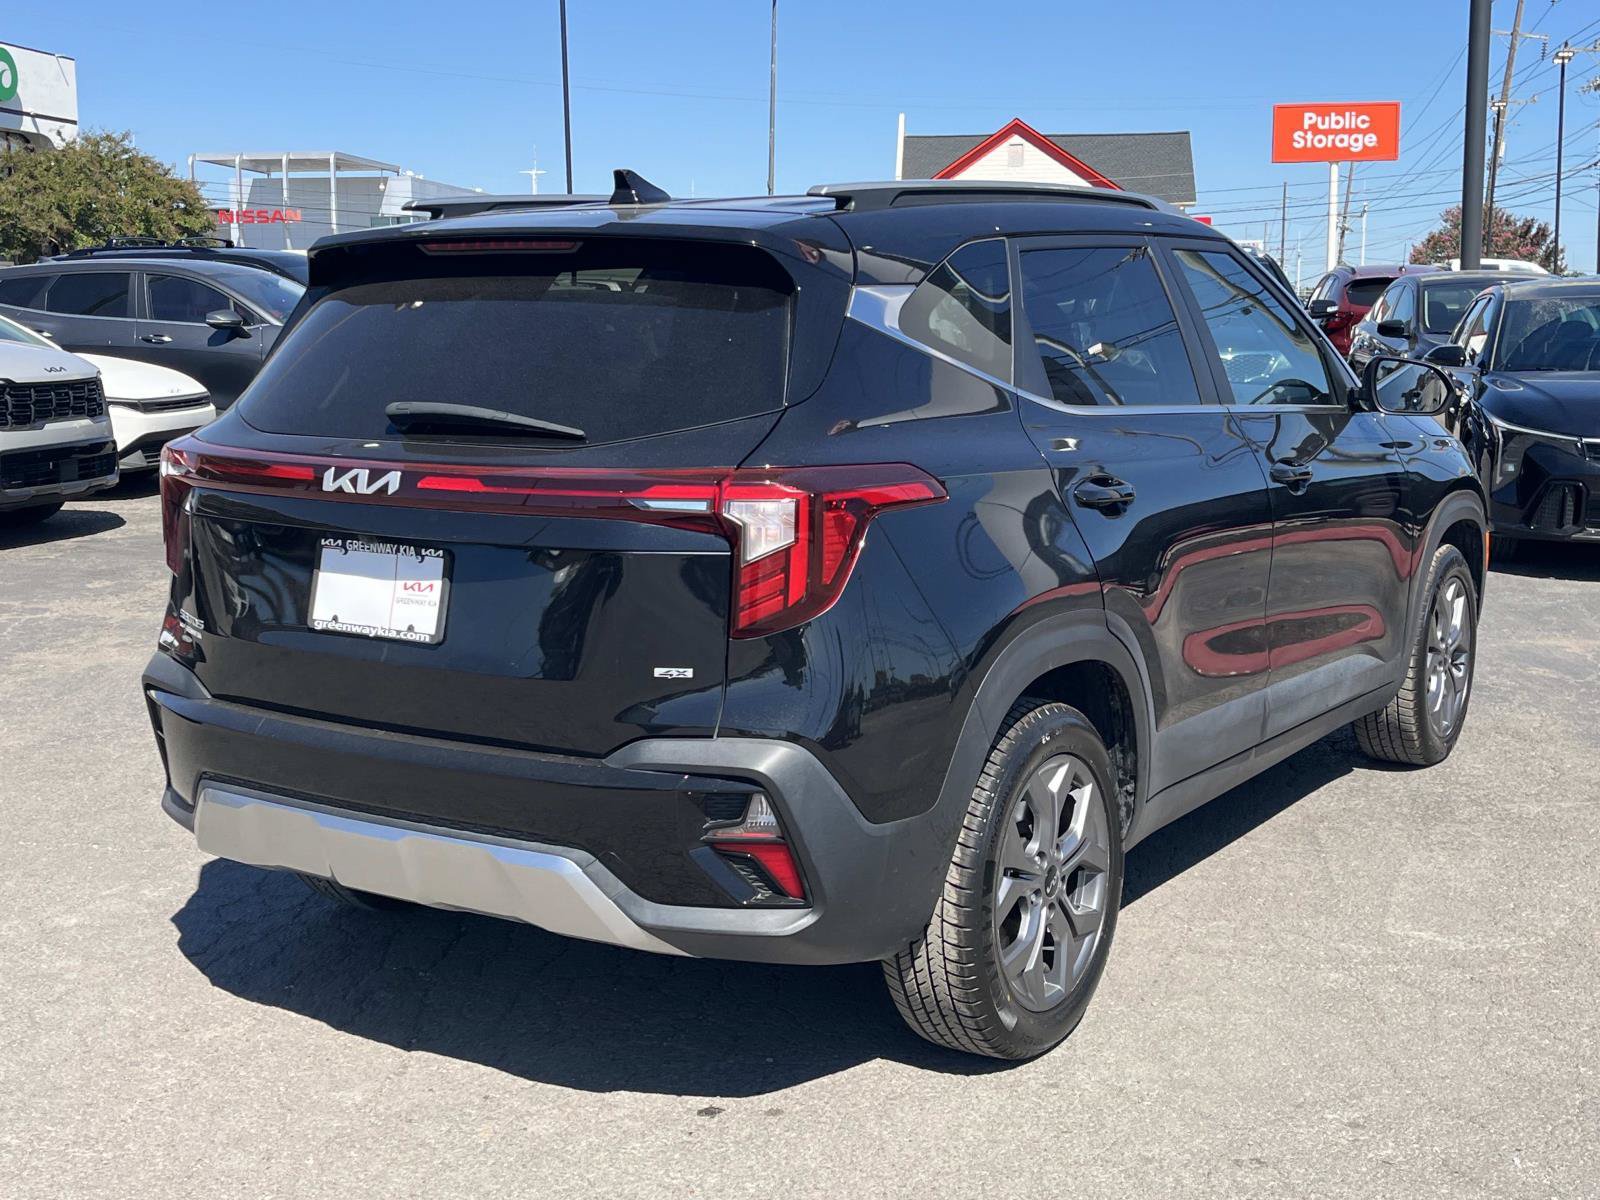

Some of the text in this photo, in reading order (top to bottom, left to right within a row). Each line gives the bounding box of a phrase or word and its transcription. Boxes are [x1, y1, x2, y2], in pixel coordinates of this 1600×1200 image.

[1304, 112, 1370, 129] Public
[1293, 131, 1377, 152] Storage
[218, 208, 302, 224] NISSAN
[322, 467, 401, 495] KIA
[321, 538, 443, 557] KIA GREENWAY KIA KIA
[404, 582, 433, 592] KIA
[314, 620, 430, 641] greenwaykia.com
